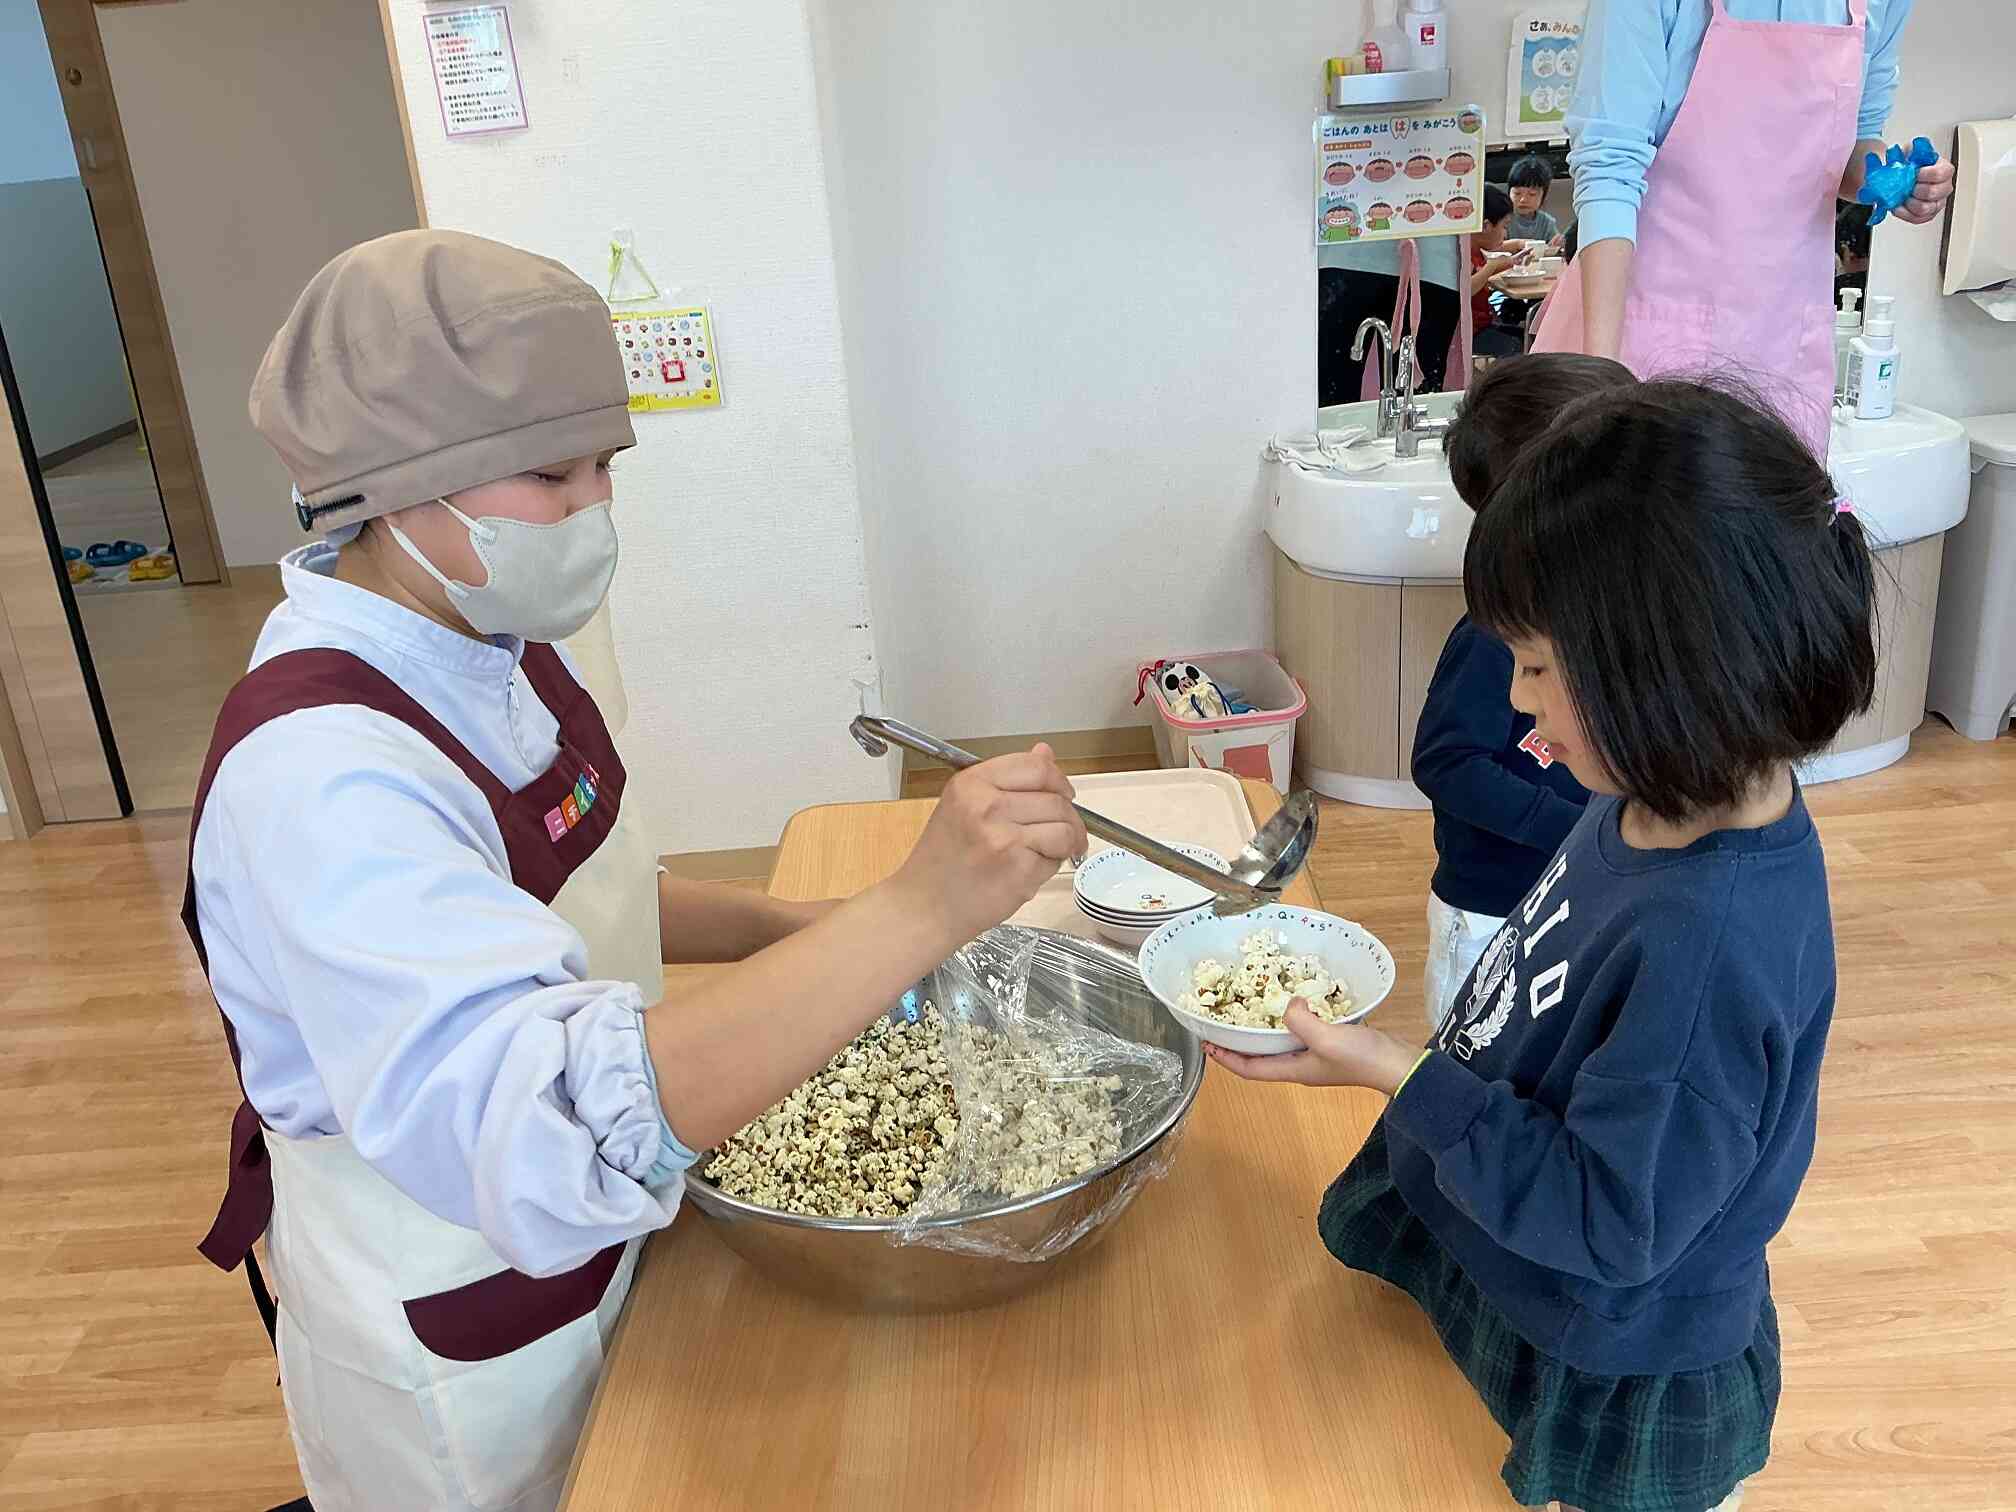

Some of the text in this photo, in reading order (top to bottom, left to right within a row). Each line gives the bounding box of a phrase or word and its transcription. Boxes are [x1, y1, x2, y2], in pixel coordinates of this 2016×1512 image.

[1323, 125, 1359, 137] ごはんの
[1363, 123, 1388, 134] あとは
[1423, 118, 1456, 129] みがこう
